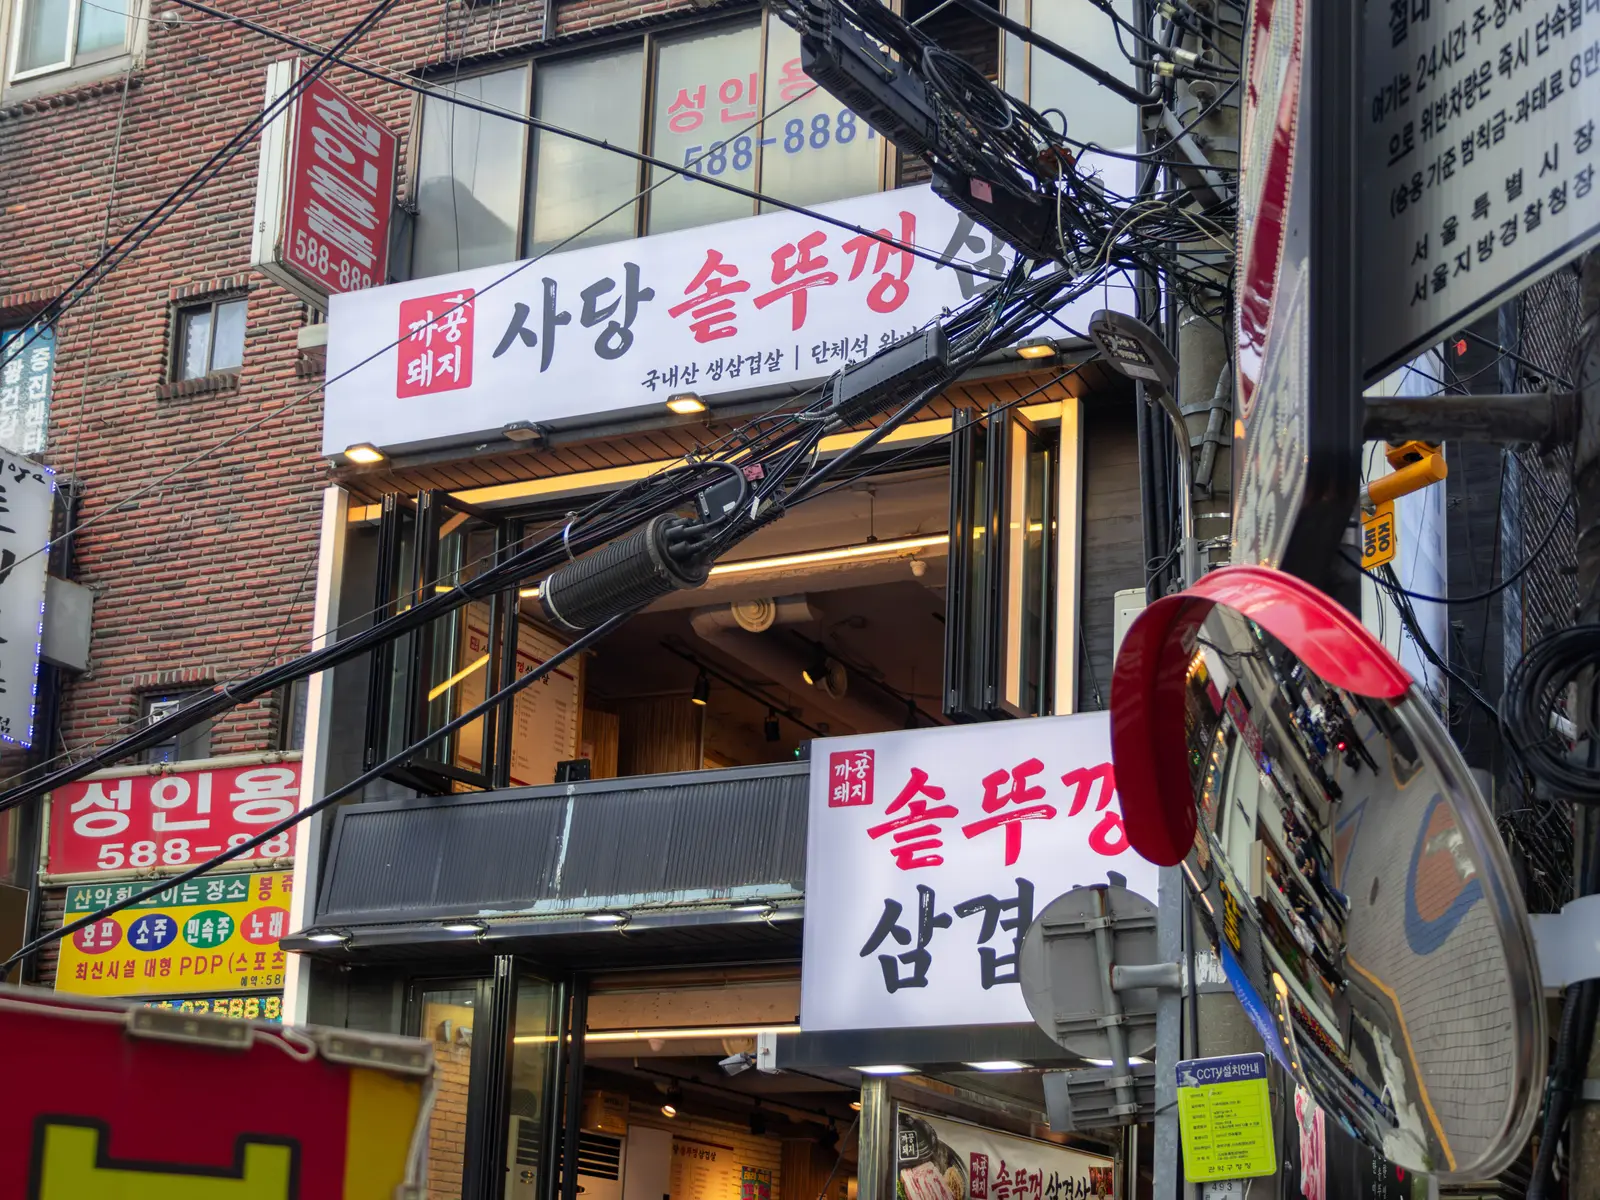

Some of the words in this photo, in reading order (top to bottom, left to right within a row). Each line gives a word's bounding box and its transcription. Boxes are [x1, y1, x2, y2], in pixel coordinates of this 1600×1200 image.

[1372, 71, 1411, 124] 여기는
[1416, 20, 1467, 93] 24시간
[1388, 120, 1415, 167] 으로
[1420, 60, 1492, 142] 위반차량은
[1498, 28, 1529, 79] 즉시
[682, 108, 875, 181] 588-888
[303, 93, 381, 269] 성인용품
[1410, 163, 1595, 306] 서울지방경찰청장
[492, 262, 656, 373] 사당
[668, 211, 917, 343] 솥뚜껑
[405, 345, 462, 387] 돼지
[641, 362, 700, 392] 국내산
[706, 348, 784, 381] 생삼겹살
[811, 333, 869, 364] 단체석
[834, 752, 872, 780] 까꿍
[70, 767, 299, 837] 성인용
[833, 780, 866, 802] 돼지
[74, 886, 133, 909] 산악회
[206, 879, 246, 902] 장소
[82, 921, 114, 948] 호프
[136, 918, 168, 945] 소주
[187, 916, 230, 944] 민속주
[250, 911, 284, 939] 노래
[860, 871, 1127, 993] 삼겹
[76, 959, 136, 981] 최신시설
[144, 957, 172, 978] 대형
[180, 954, 223, 976] PDP
[240, 974, 285, 987] 예약:58
